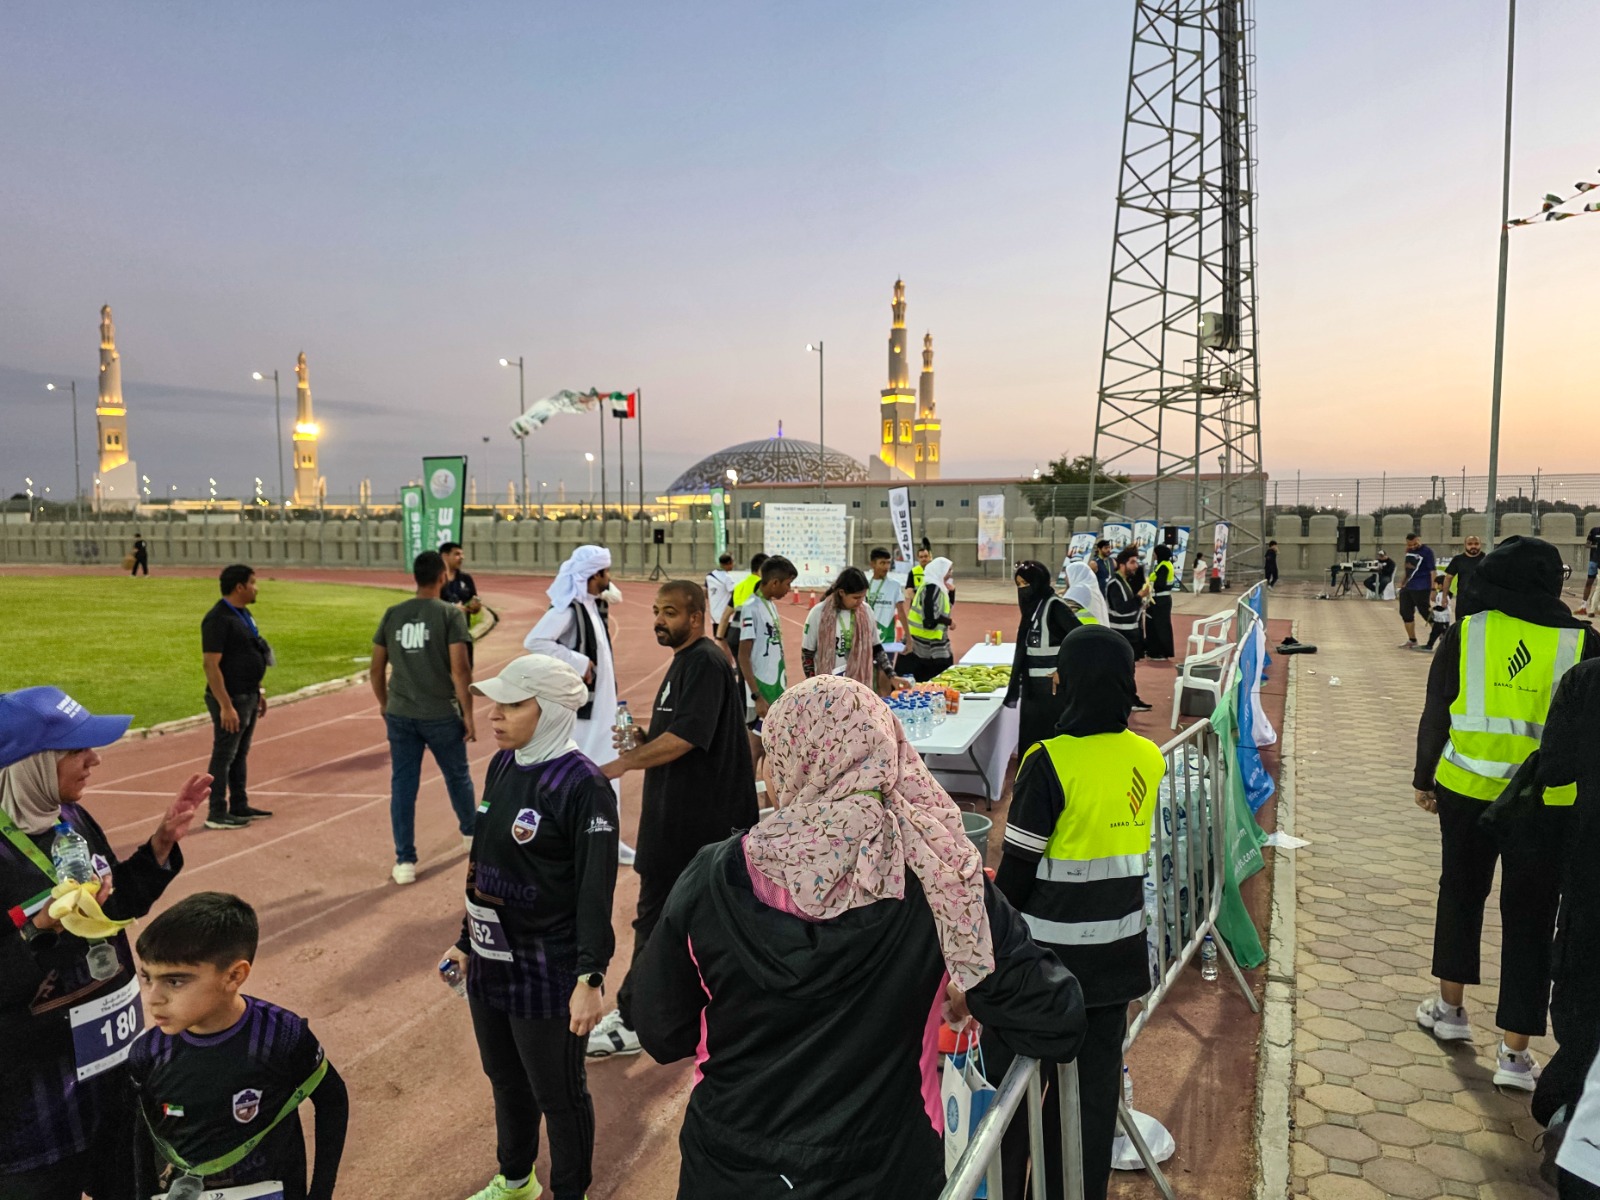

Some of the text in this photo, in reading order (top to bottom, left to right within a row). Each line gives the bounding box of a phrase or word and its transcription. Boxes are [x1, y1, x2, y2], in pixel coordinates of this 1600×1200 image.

[401, 622, 425, 649] ON
[470, 918, 495, 945] 152
[101, 1004, 137, 1047] 180
